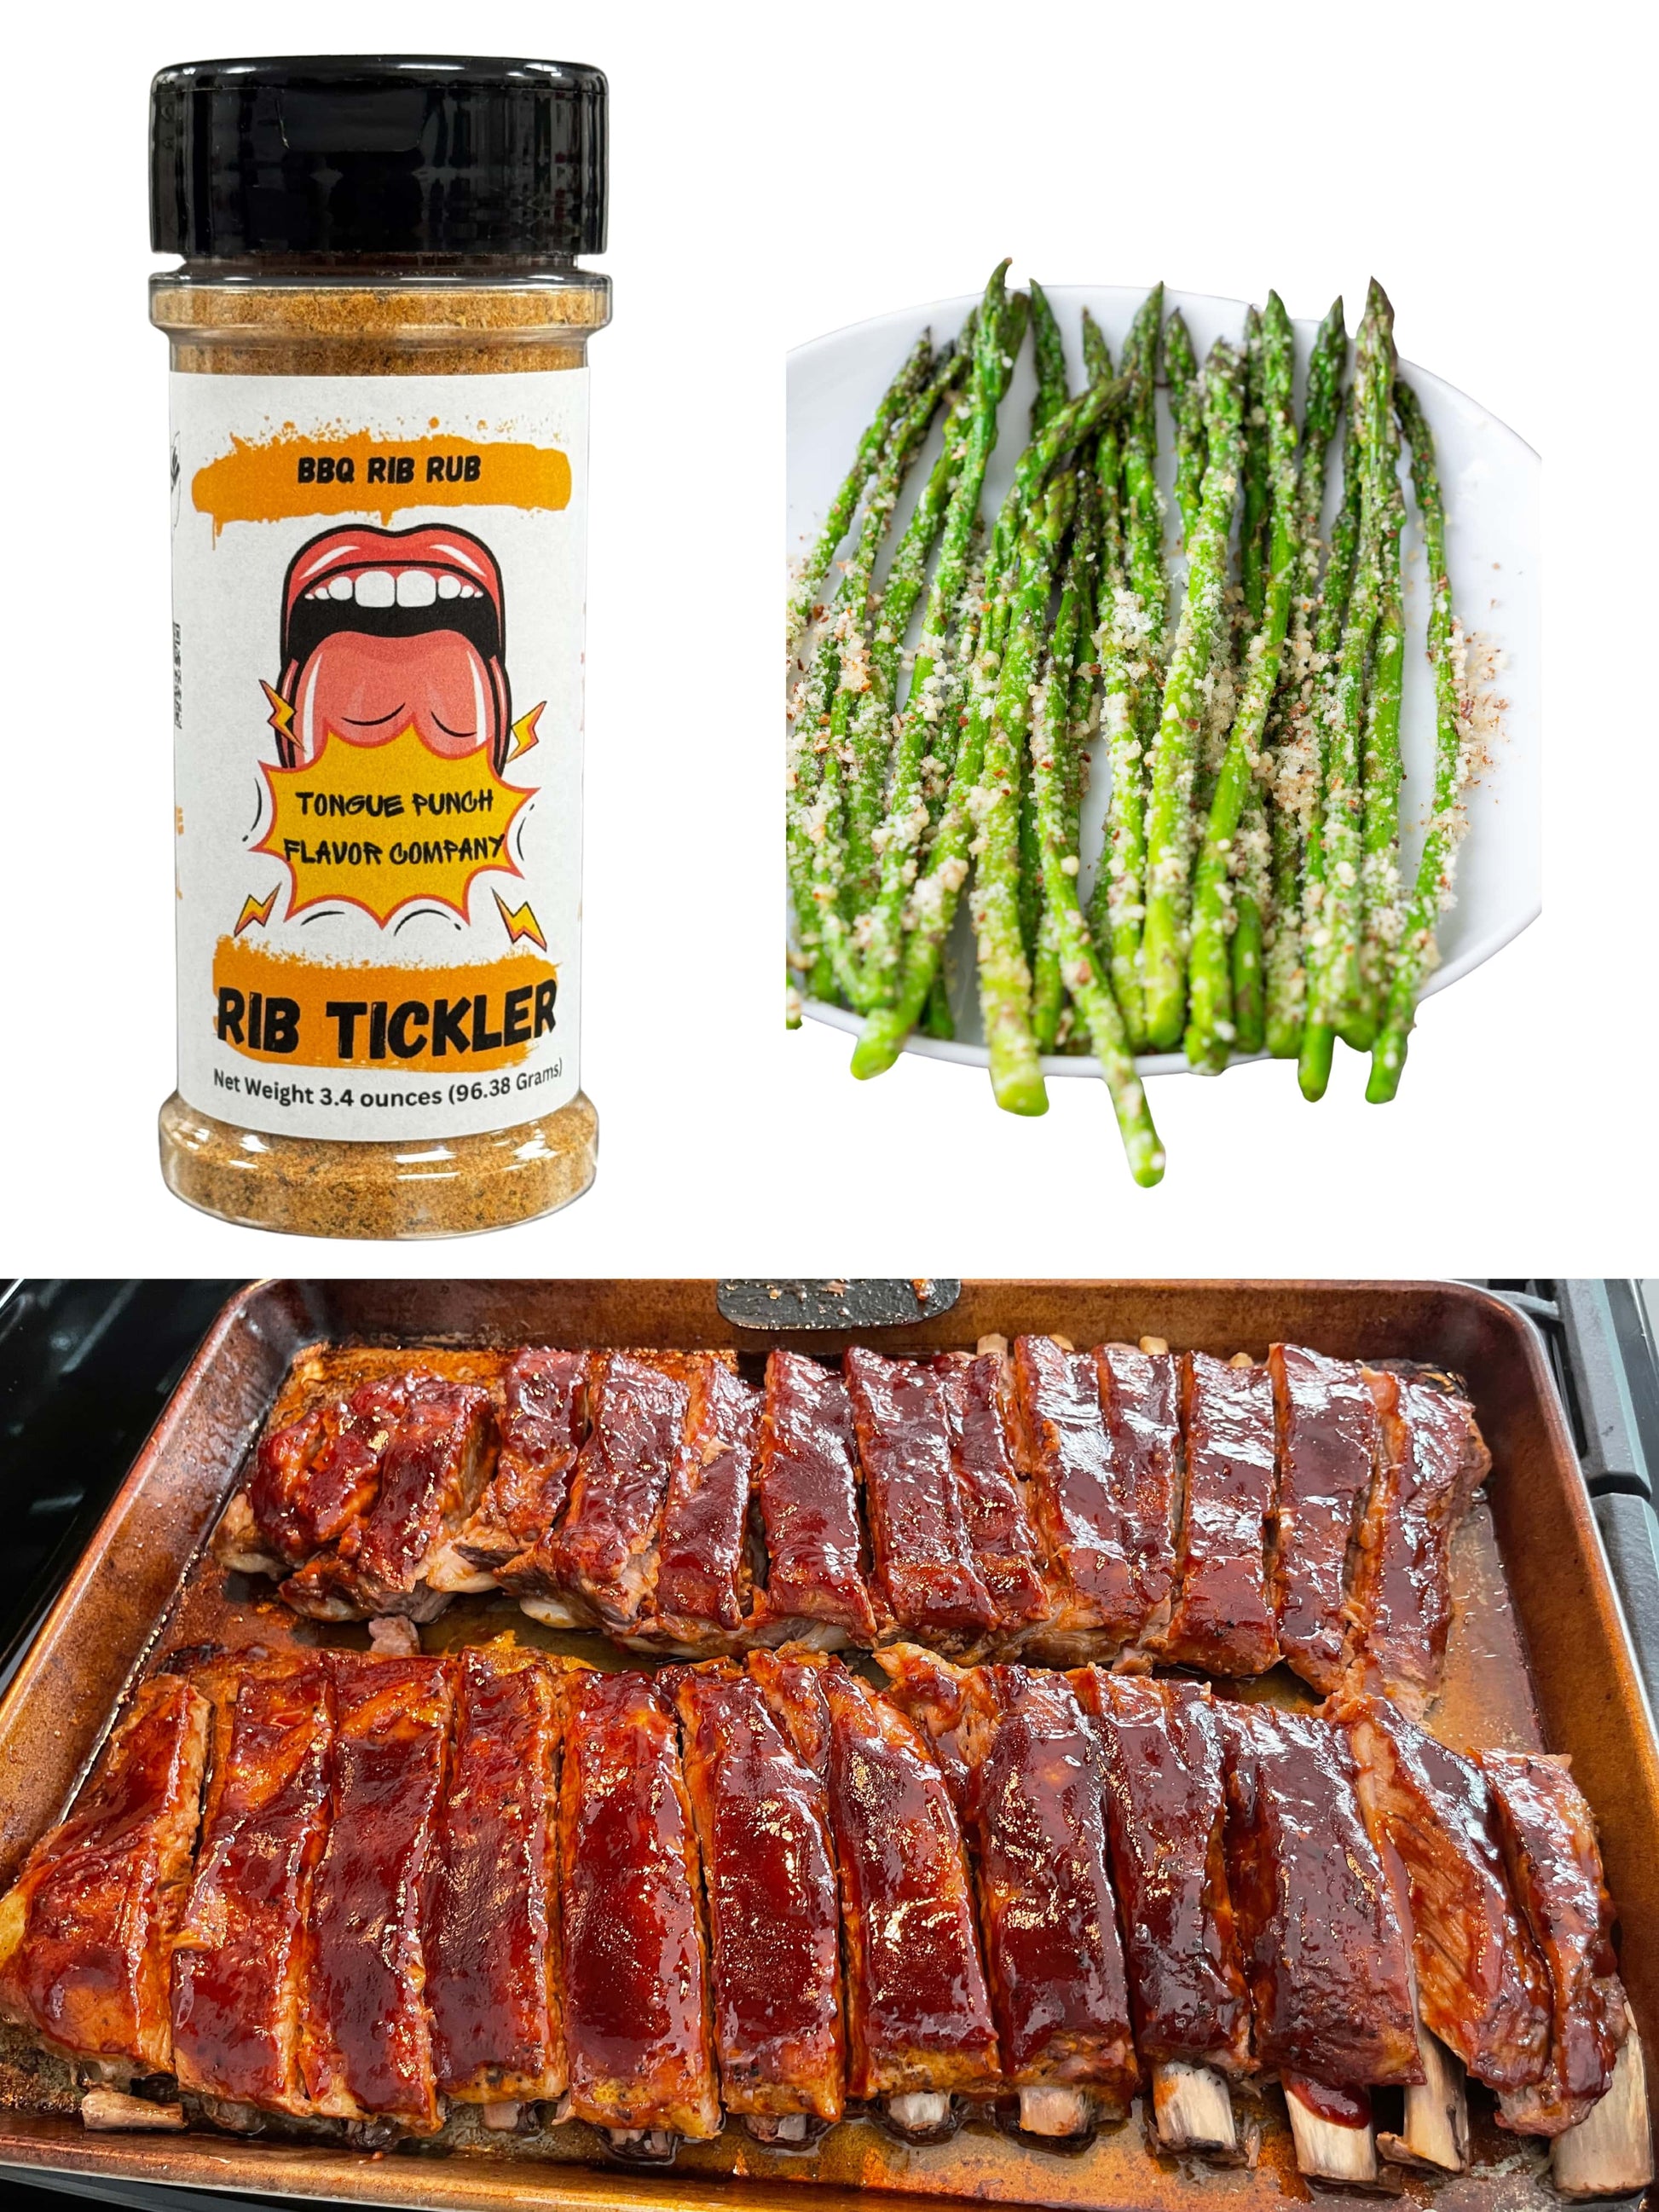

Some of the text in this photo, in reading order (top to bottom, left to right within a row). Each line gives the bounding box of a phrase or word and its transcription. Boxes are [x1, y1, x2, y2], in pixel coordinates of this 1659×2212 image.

[297, 455, 482, 484] BBQ RIB RUB
[295, 788, 494, 818] TONGUE PUNCH
[283, 834, 506, 865] FLAVOR COMPANY
[217, 979, 558, 1060] RIB TICKLER
[213, 1057, 563, 1107] Net Weight 3.4 ounces (96.38 Grams)
